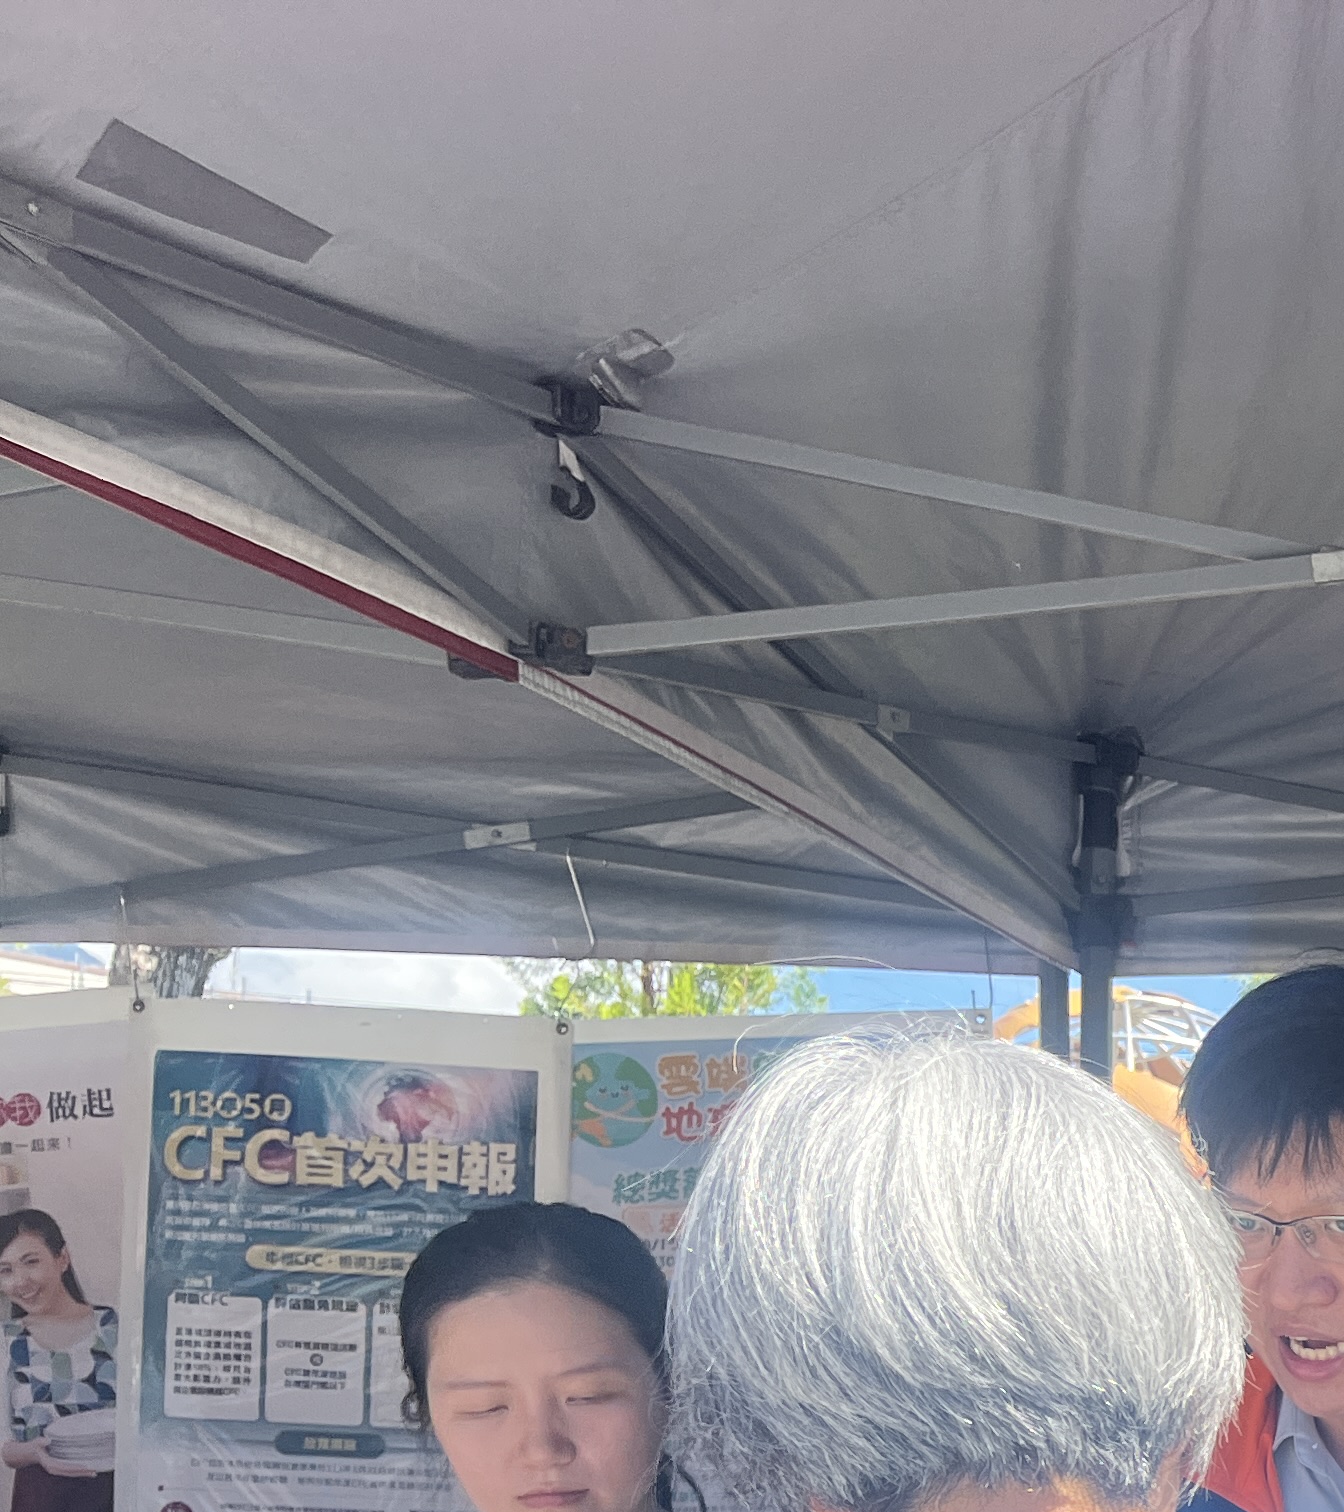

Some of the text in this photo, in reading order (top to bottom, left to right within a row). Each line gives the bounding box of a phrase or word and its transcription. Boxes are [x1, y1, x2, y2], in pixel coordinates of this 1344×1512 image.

[0, 1088, 115, 1127] 我做起
[163, 1123, 518, 1196] CFC首次申報
